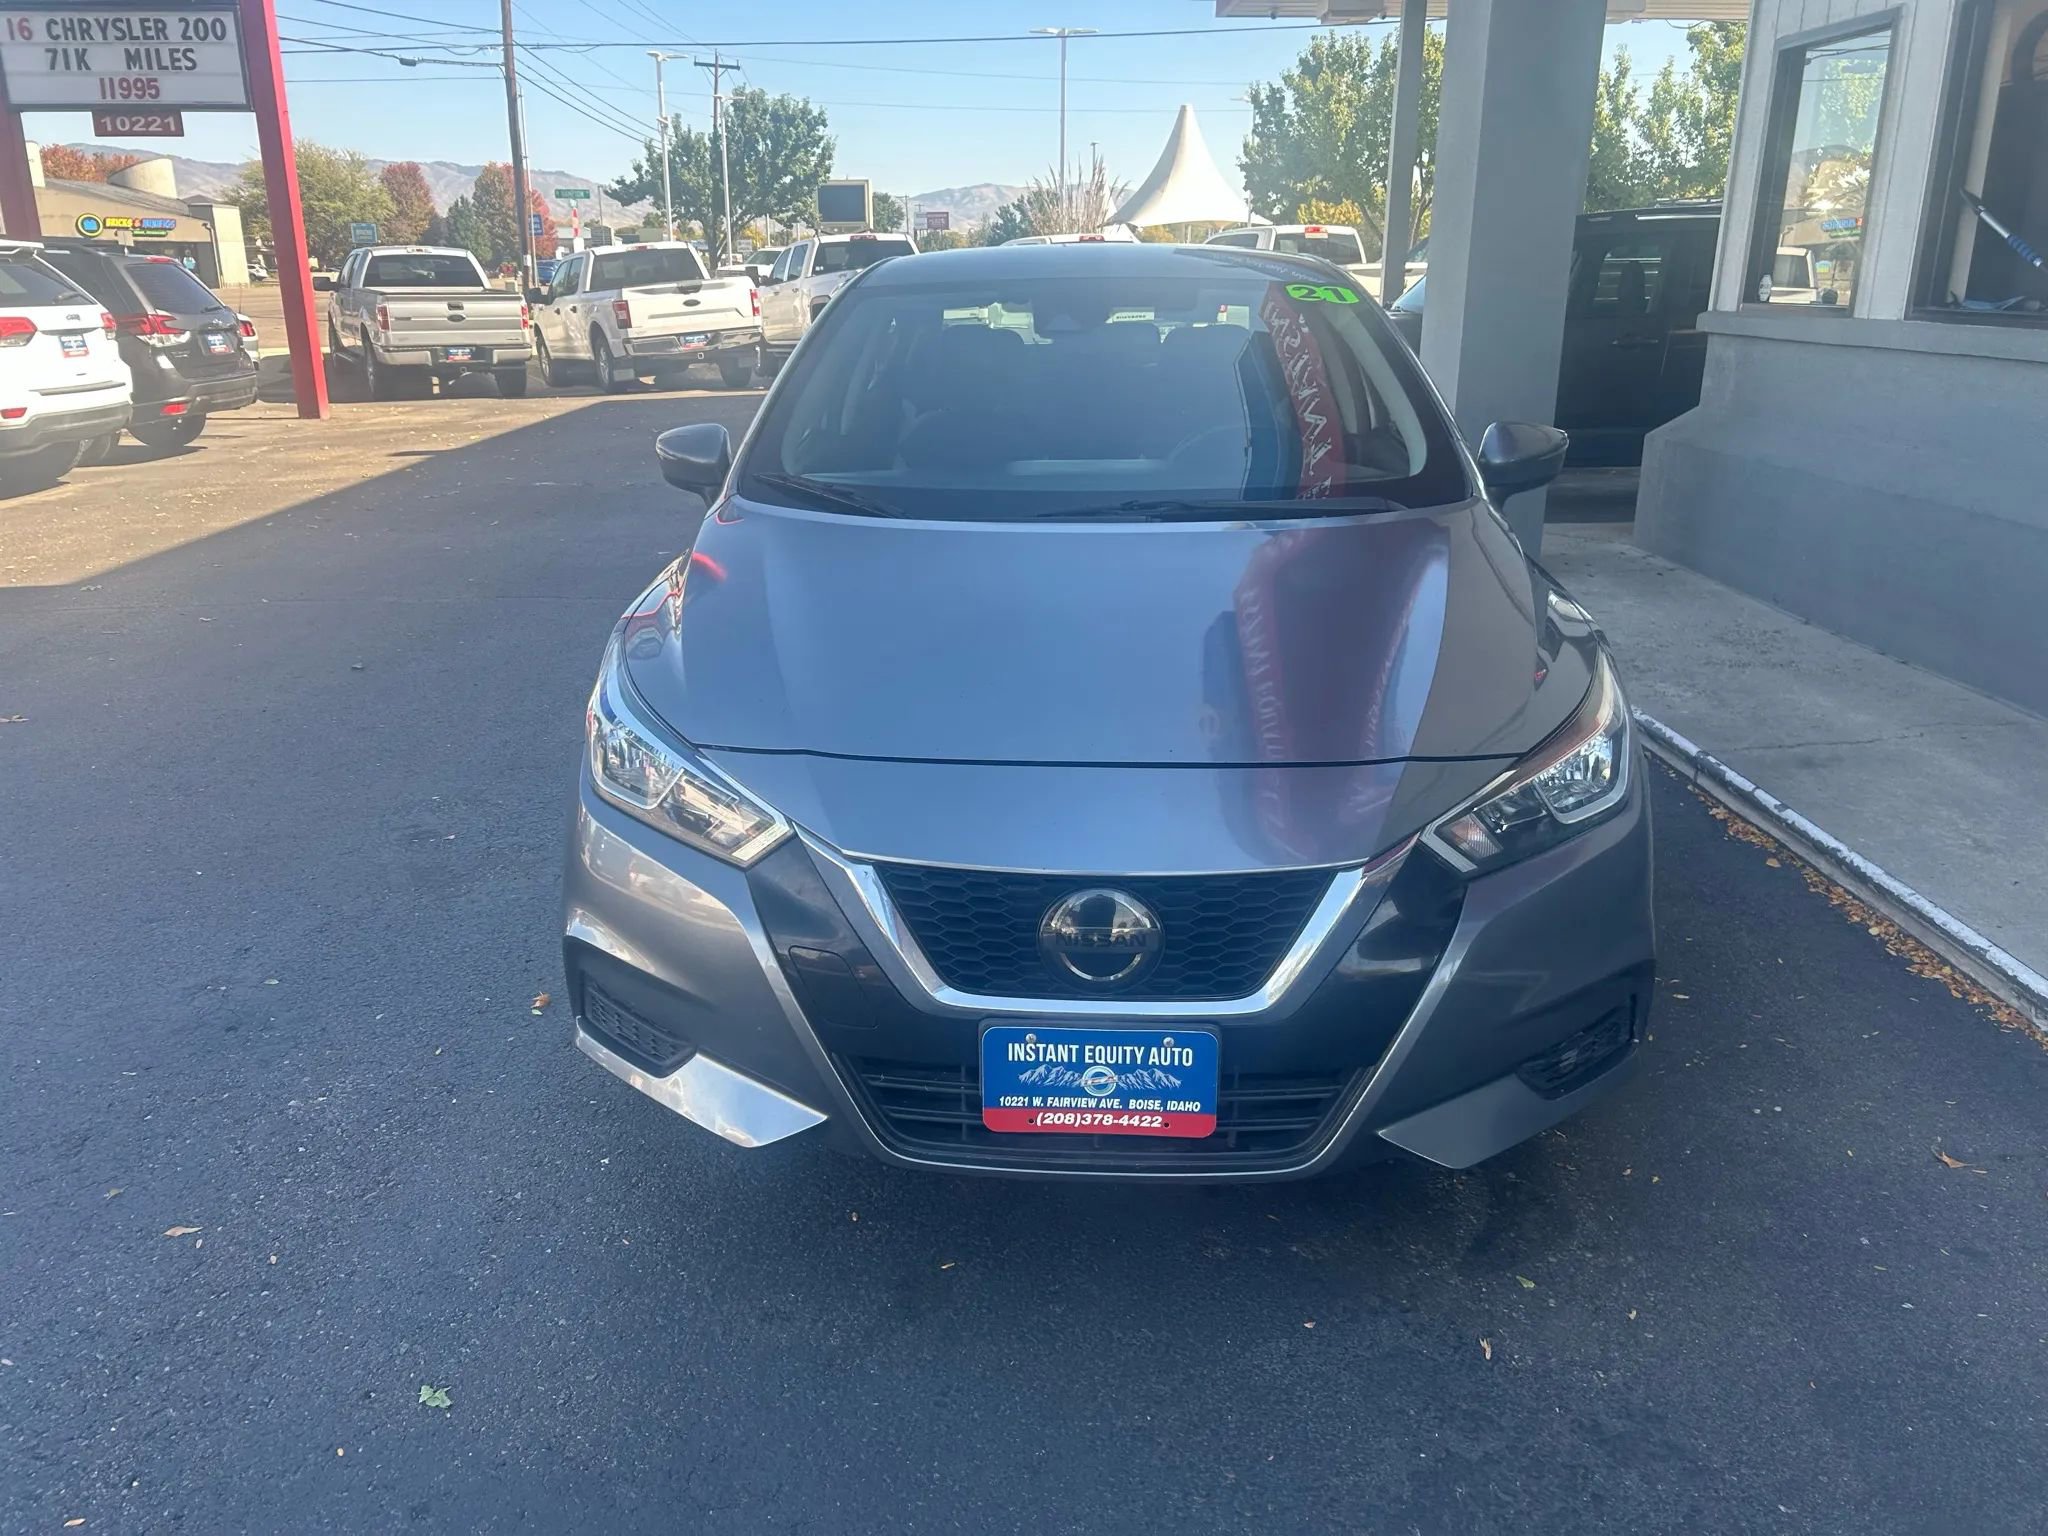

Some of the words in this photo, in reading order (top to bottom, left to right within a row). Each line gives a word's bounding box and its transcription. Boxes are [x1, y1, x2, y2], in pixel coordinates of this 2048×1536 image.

[7, 18, 33, 41] 16
[46, 17, 169, 41] CHRYSLER
[178, 17, 227, 41] 200
[45, 48, 91, 71] 71K
[124, 48, 197, 71] MILES
[100, 77, 160, 99] 11995
[101, 116, 176, 132] 10221
[1292, 286, 1347, 302] 21
[1056, 931, 1148, 947] NISSAN
[1008, 1042, 1079, 1063] INSTANT
[1084, 1045, 1144, 1066] EQUITY
[1149, 1047, 1193, 1067] AUTO
[1000, 1096, 1028, 1107] 10221
[1033, 1097, 1044, 1108] W.
[1047, 1097, 1099, 1109] FAIRVIEW
[1099, 1099, 1123, 1109] AVE.
[1129, 1099, 1163, 1112] BOISE,
[1167, 1101, 1200, 1112] IDAHO
[1036, 1112, 1162, 1128] (208)378-4422
